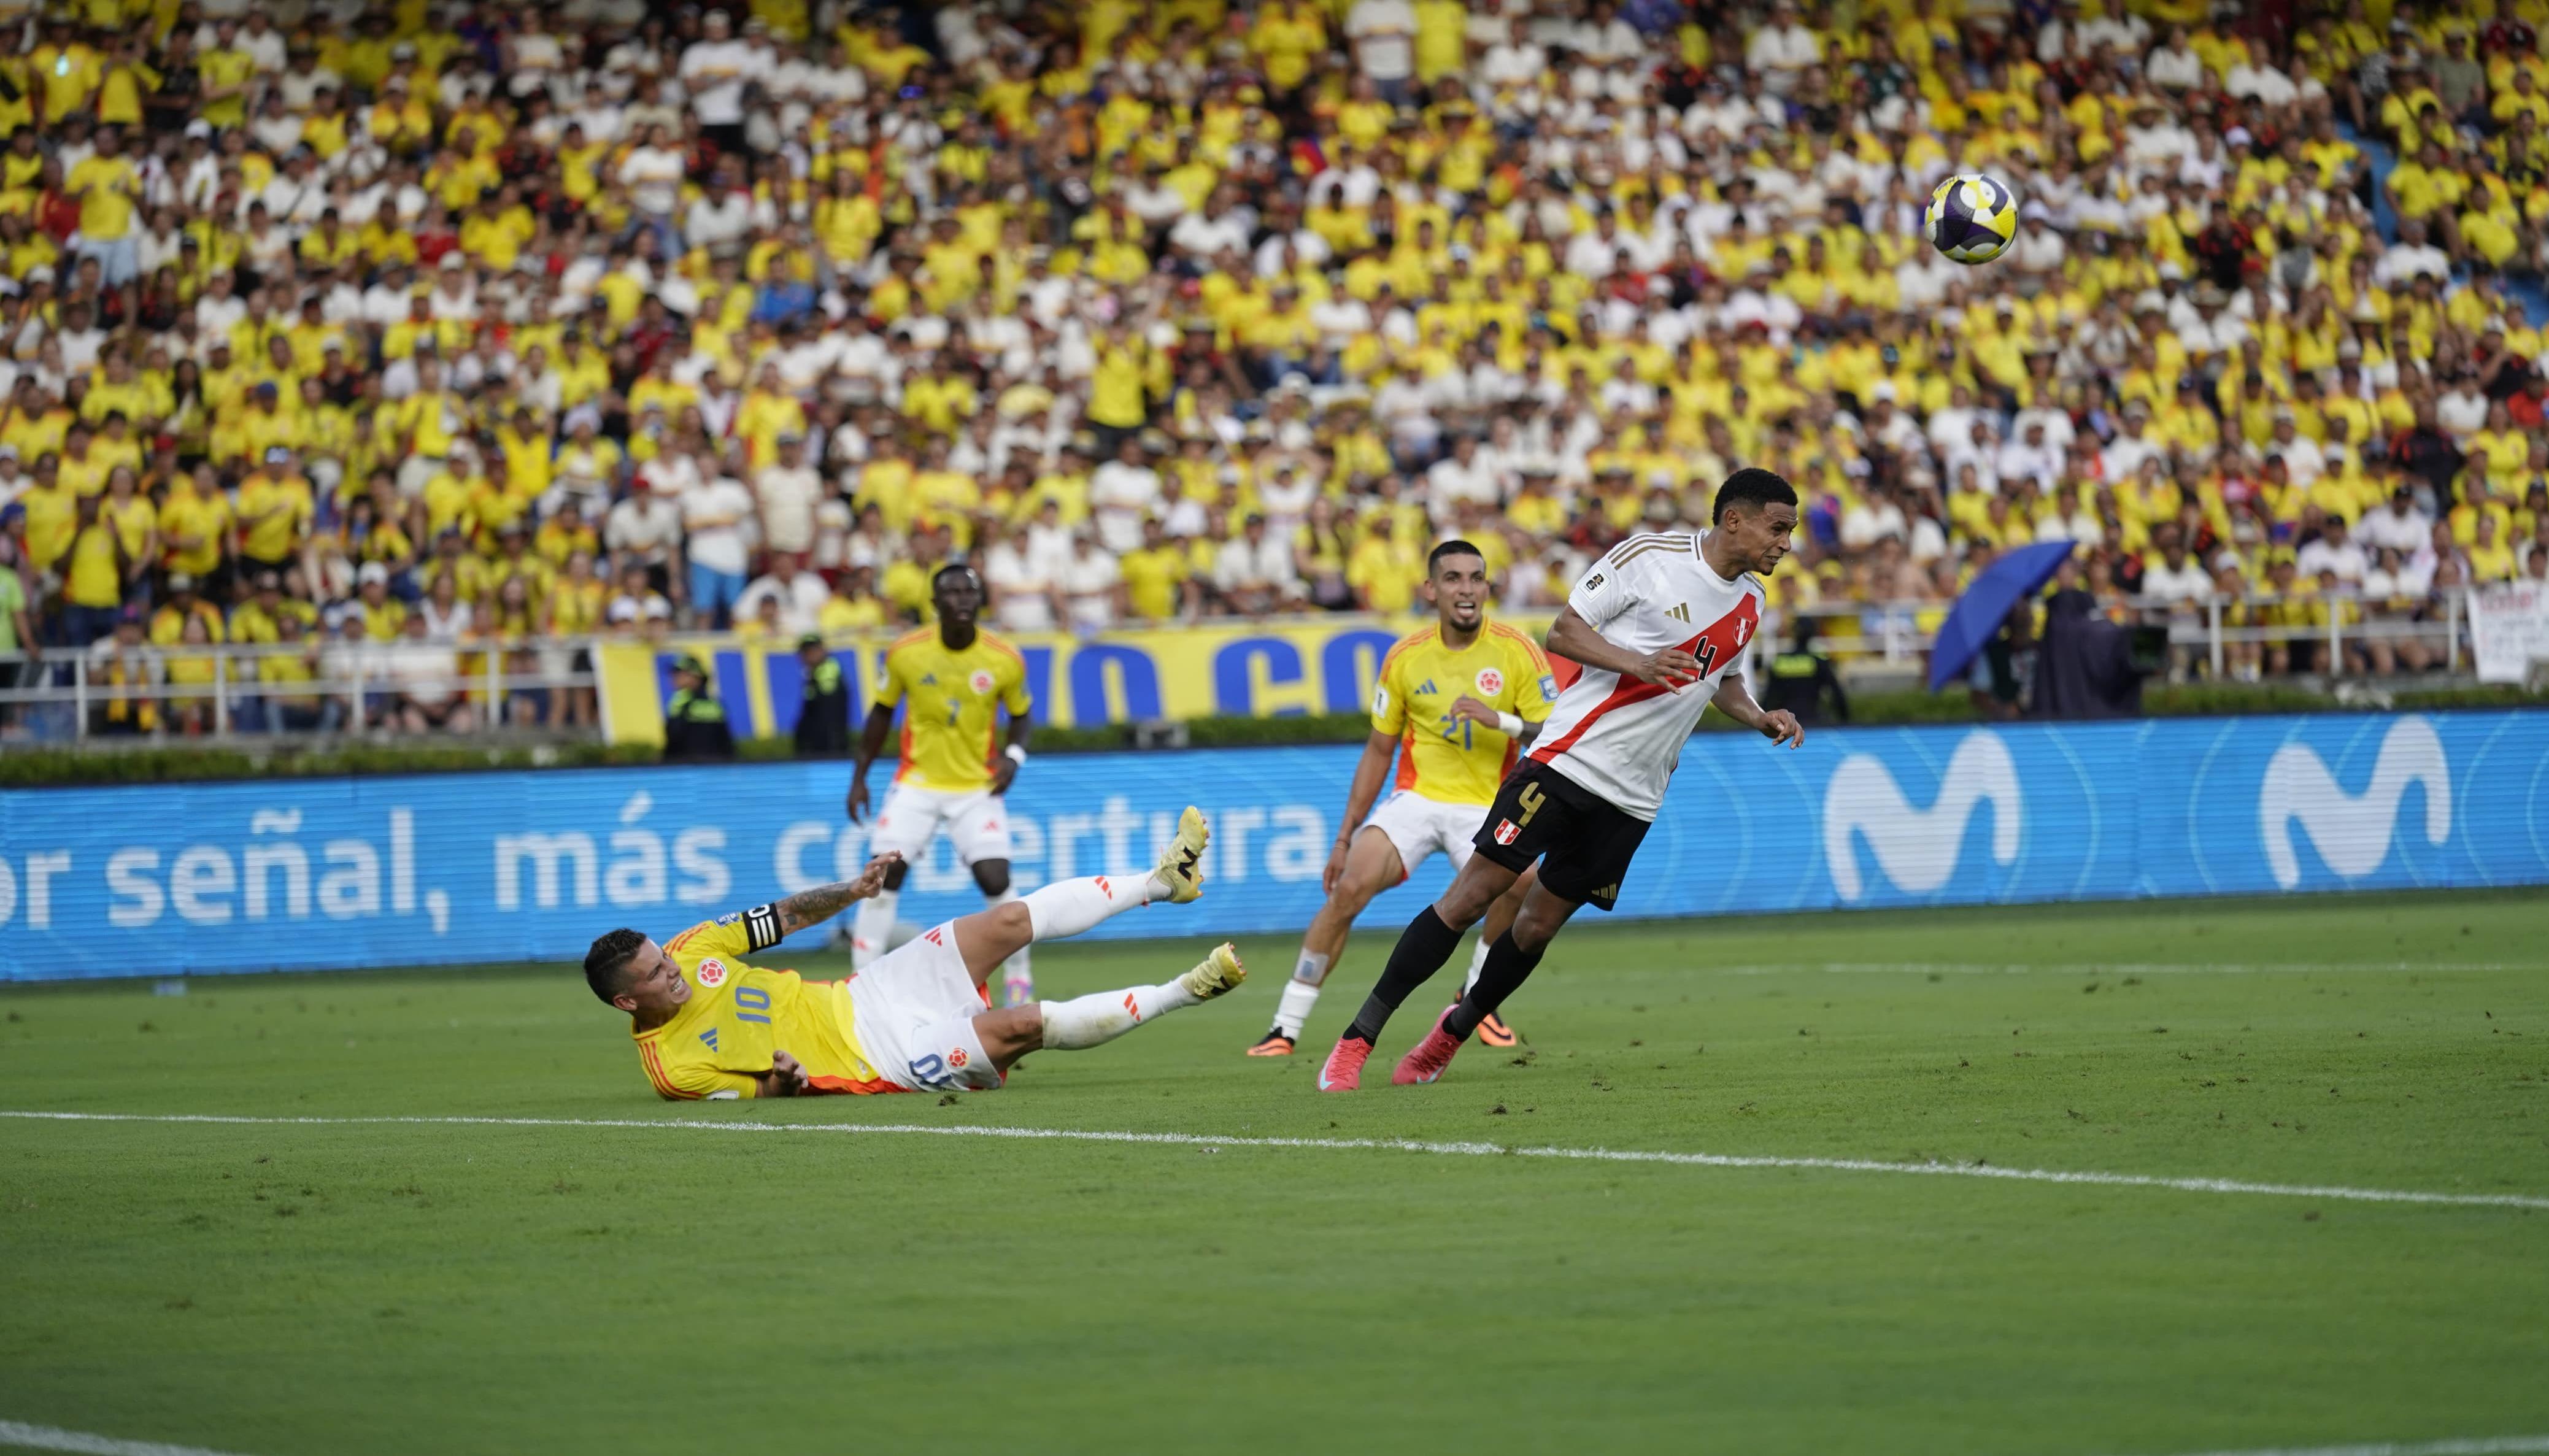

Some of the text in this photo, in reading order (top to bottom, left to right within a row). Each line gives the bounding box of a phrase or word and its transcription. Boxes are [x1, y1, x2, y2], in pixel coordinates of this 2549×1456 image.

[1694, 635, 1718, 682] 4
[946, 698, 963, 726] 7
[1519, 781, 1546, 828] 4
[105, 806, 450, 935] señal,
[495, 790, 732, 912] más
[735, 986, 771, 1025] 10
